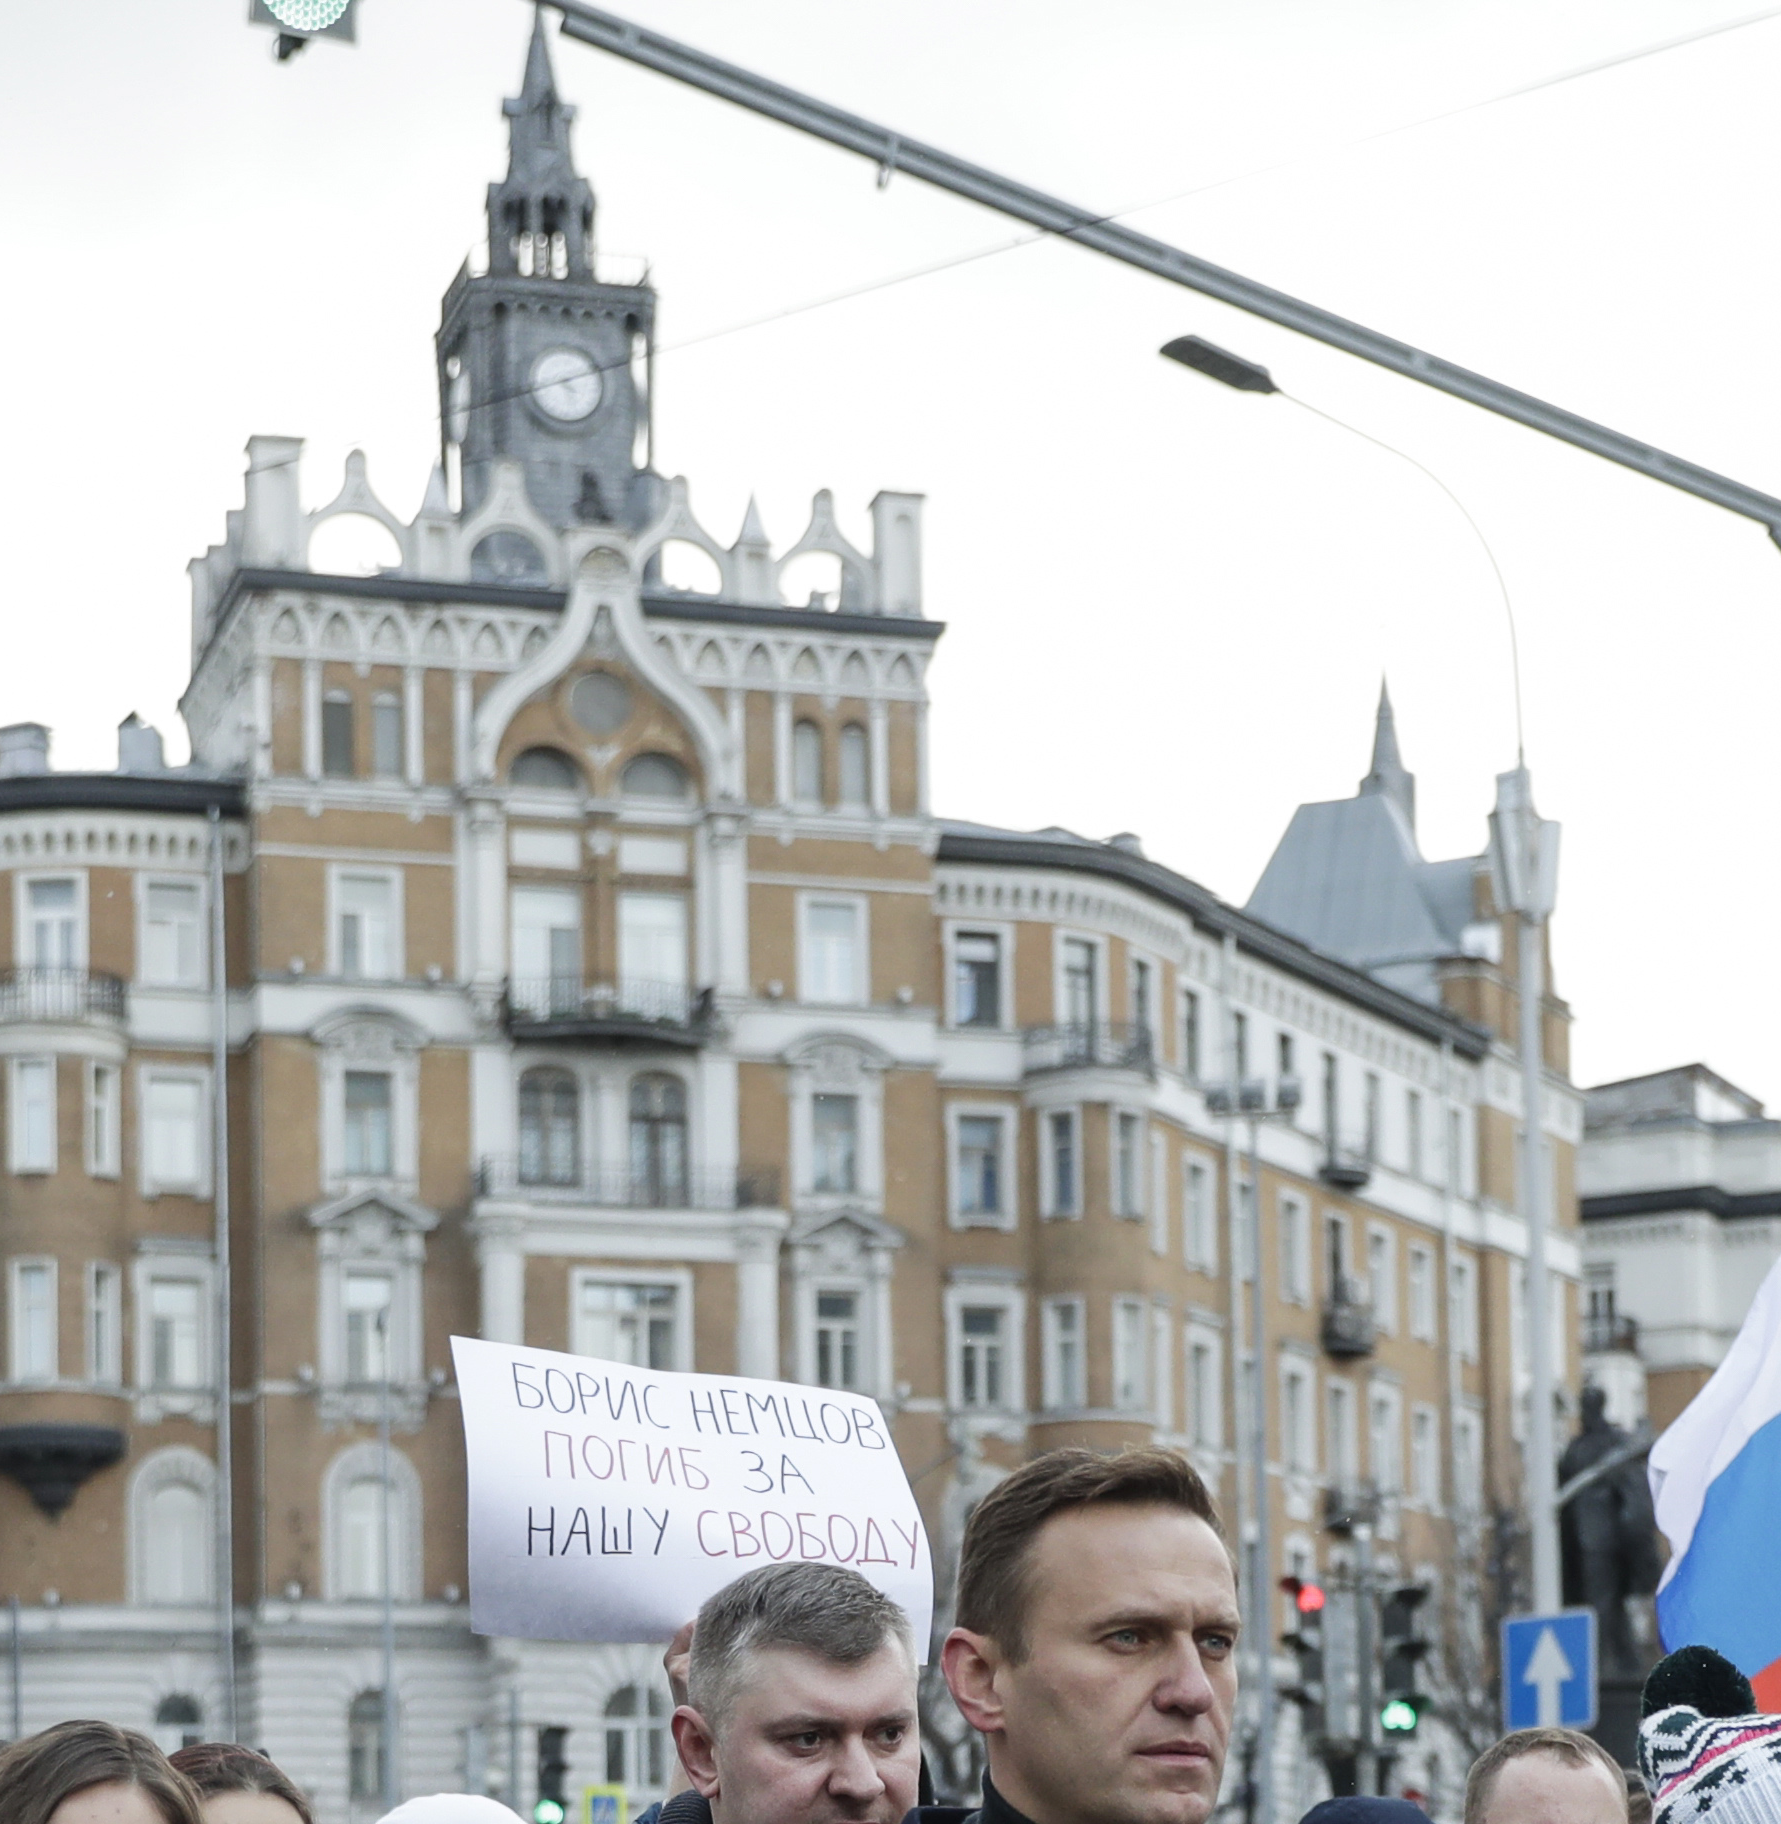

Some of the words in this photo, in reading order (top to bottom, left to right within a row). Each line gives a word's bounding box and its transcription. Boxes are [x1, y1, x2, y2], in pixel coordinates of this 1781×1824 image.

[512, 1362, 670, 1429] БОРИС
[689, 1388, 885, 1449] НЕМЦОВ
[545, 1430, 710, 1490] ПОГИБ
[741, 1450, 815, 1494] ЗА
[527, 1506, 669, 1556] НАШУ
[697, 1509, 919, 1569] СВОБОДУ
